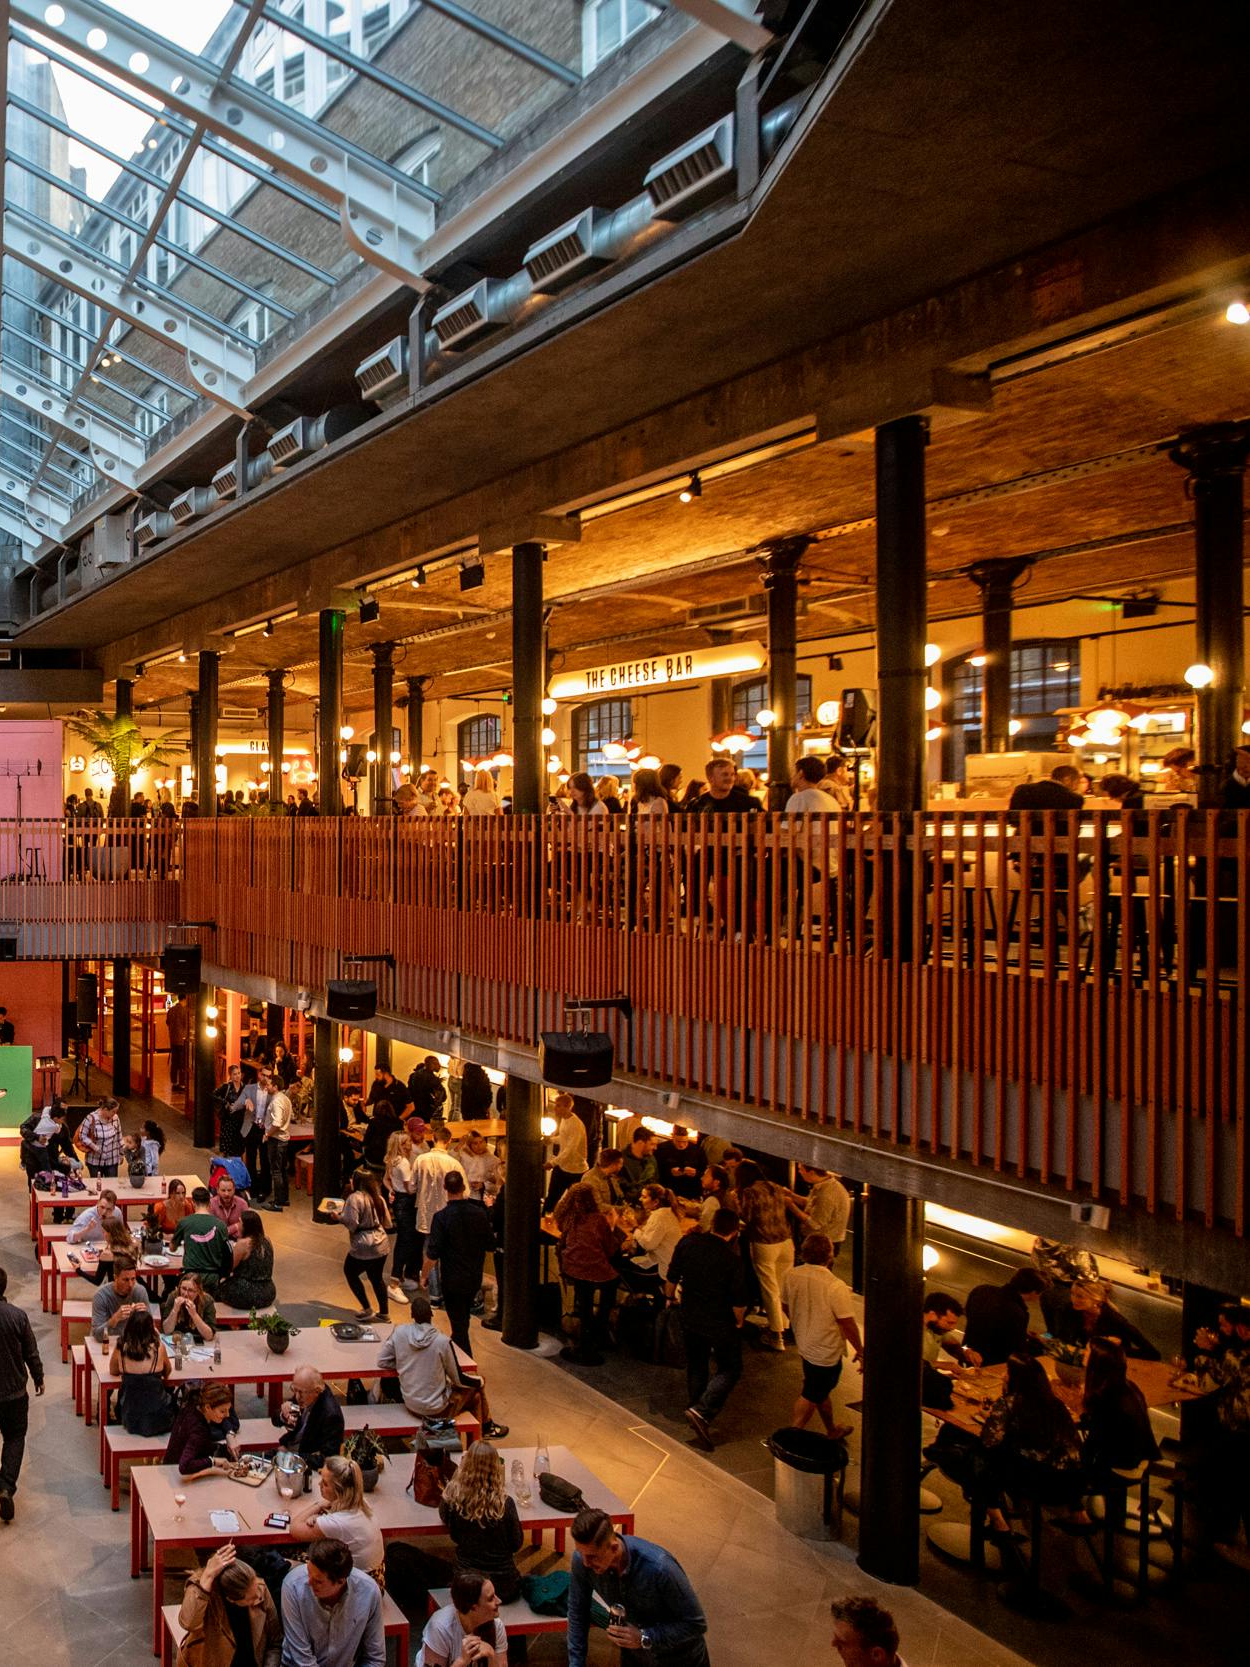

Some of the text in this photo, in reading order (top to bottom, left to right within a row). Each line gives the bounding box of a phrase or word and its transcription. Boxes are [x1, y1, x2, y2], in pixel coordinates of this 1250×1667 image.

[585, 655, 693, 689] THE CHEESE BAR
